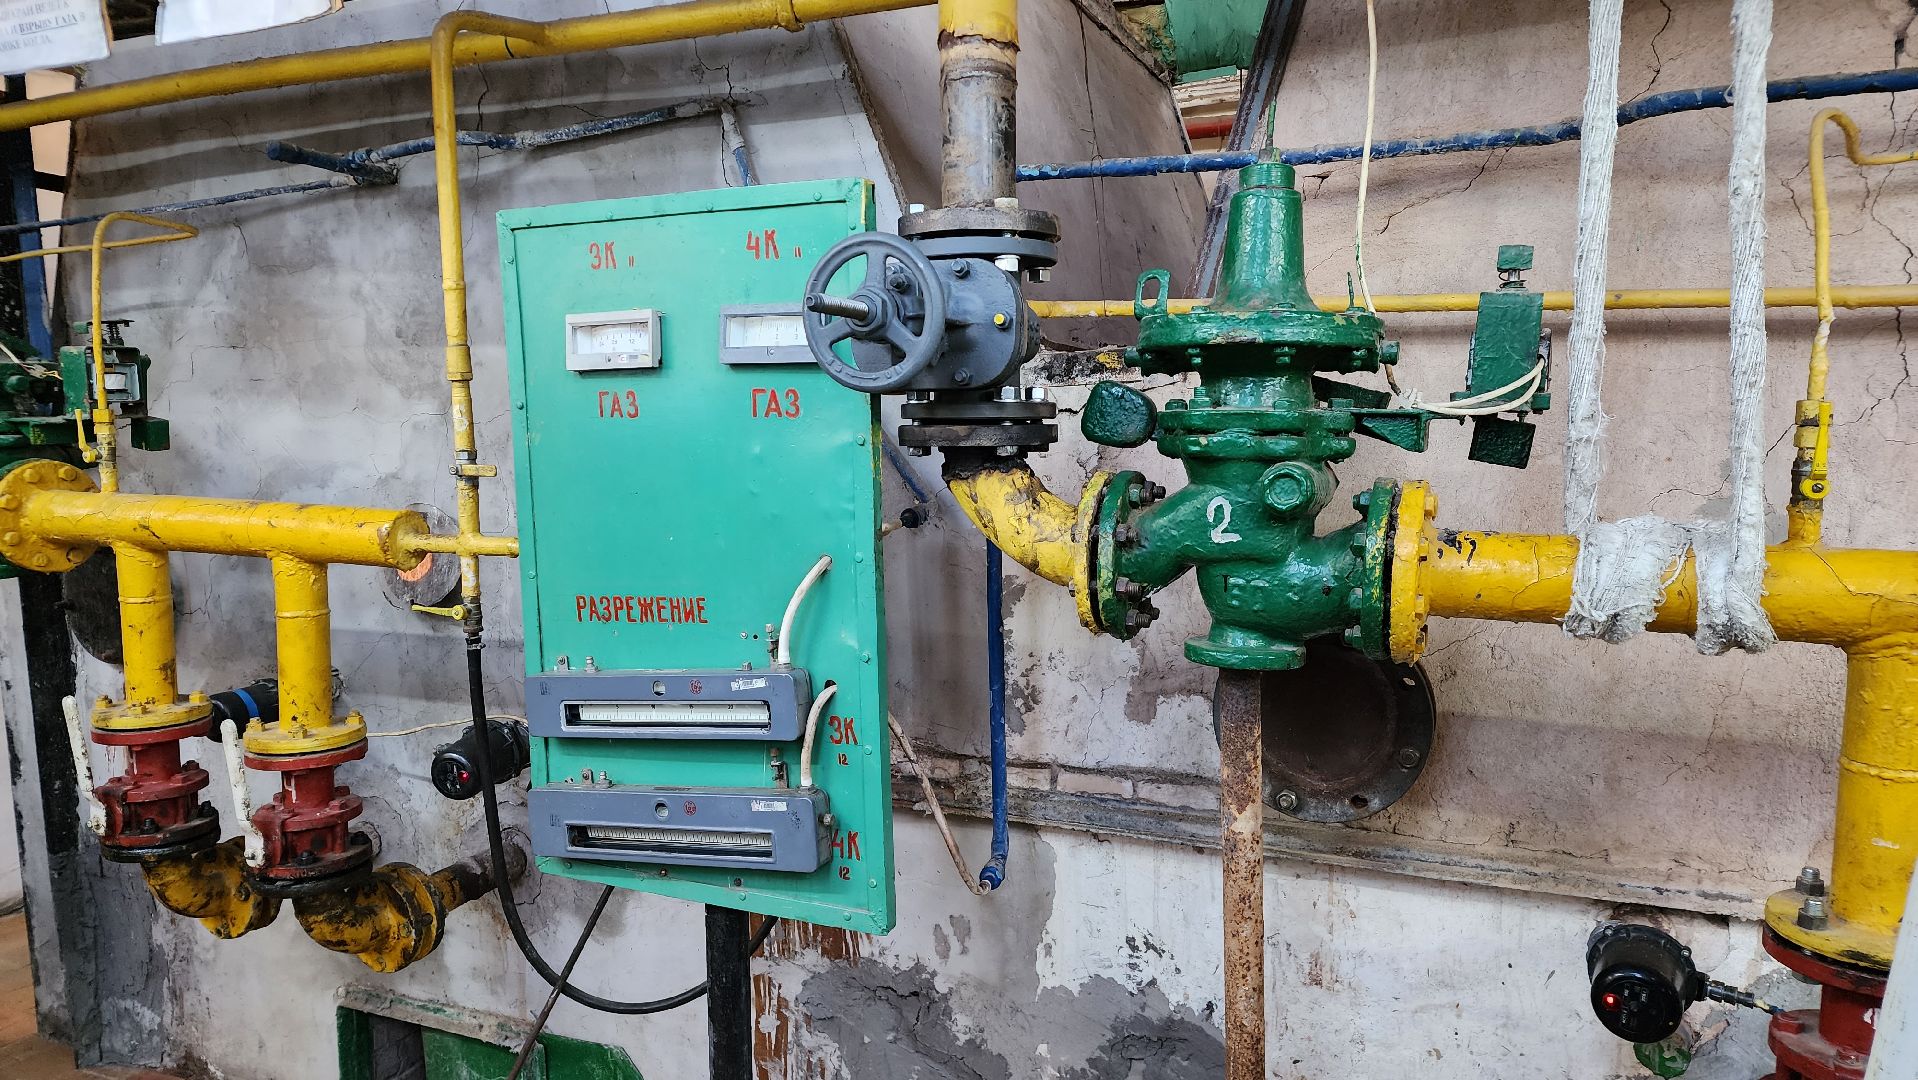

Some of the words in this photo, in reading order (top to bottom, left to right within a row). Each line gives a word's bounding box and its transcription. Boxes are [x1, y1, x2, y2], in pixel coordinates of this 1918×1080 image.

[598, 389, 640, 419] ГАЗ
[751, 387, 801, 419] ГАЗ
[1206, 495, 1242, 544] 2
[575, 594, 709, 624] РАЗРЕЖЕНИЕ
